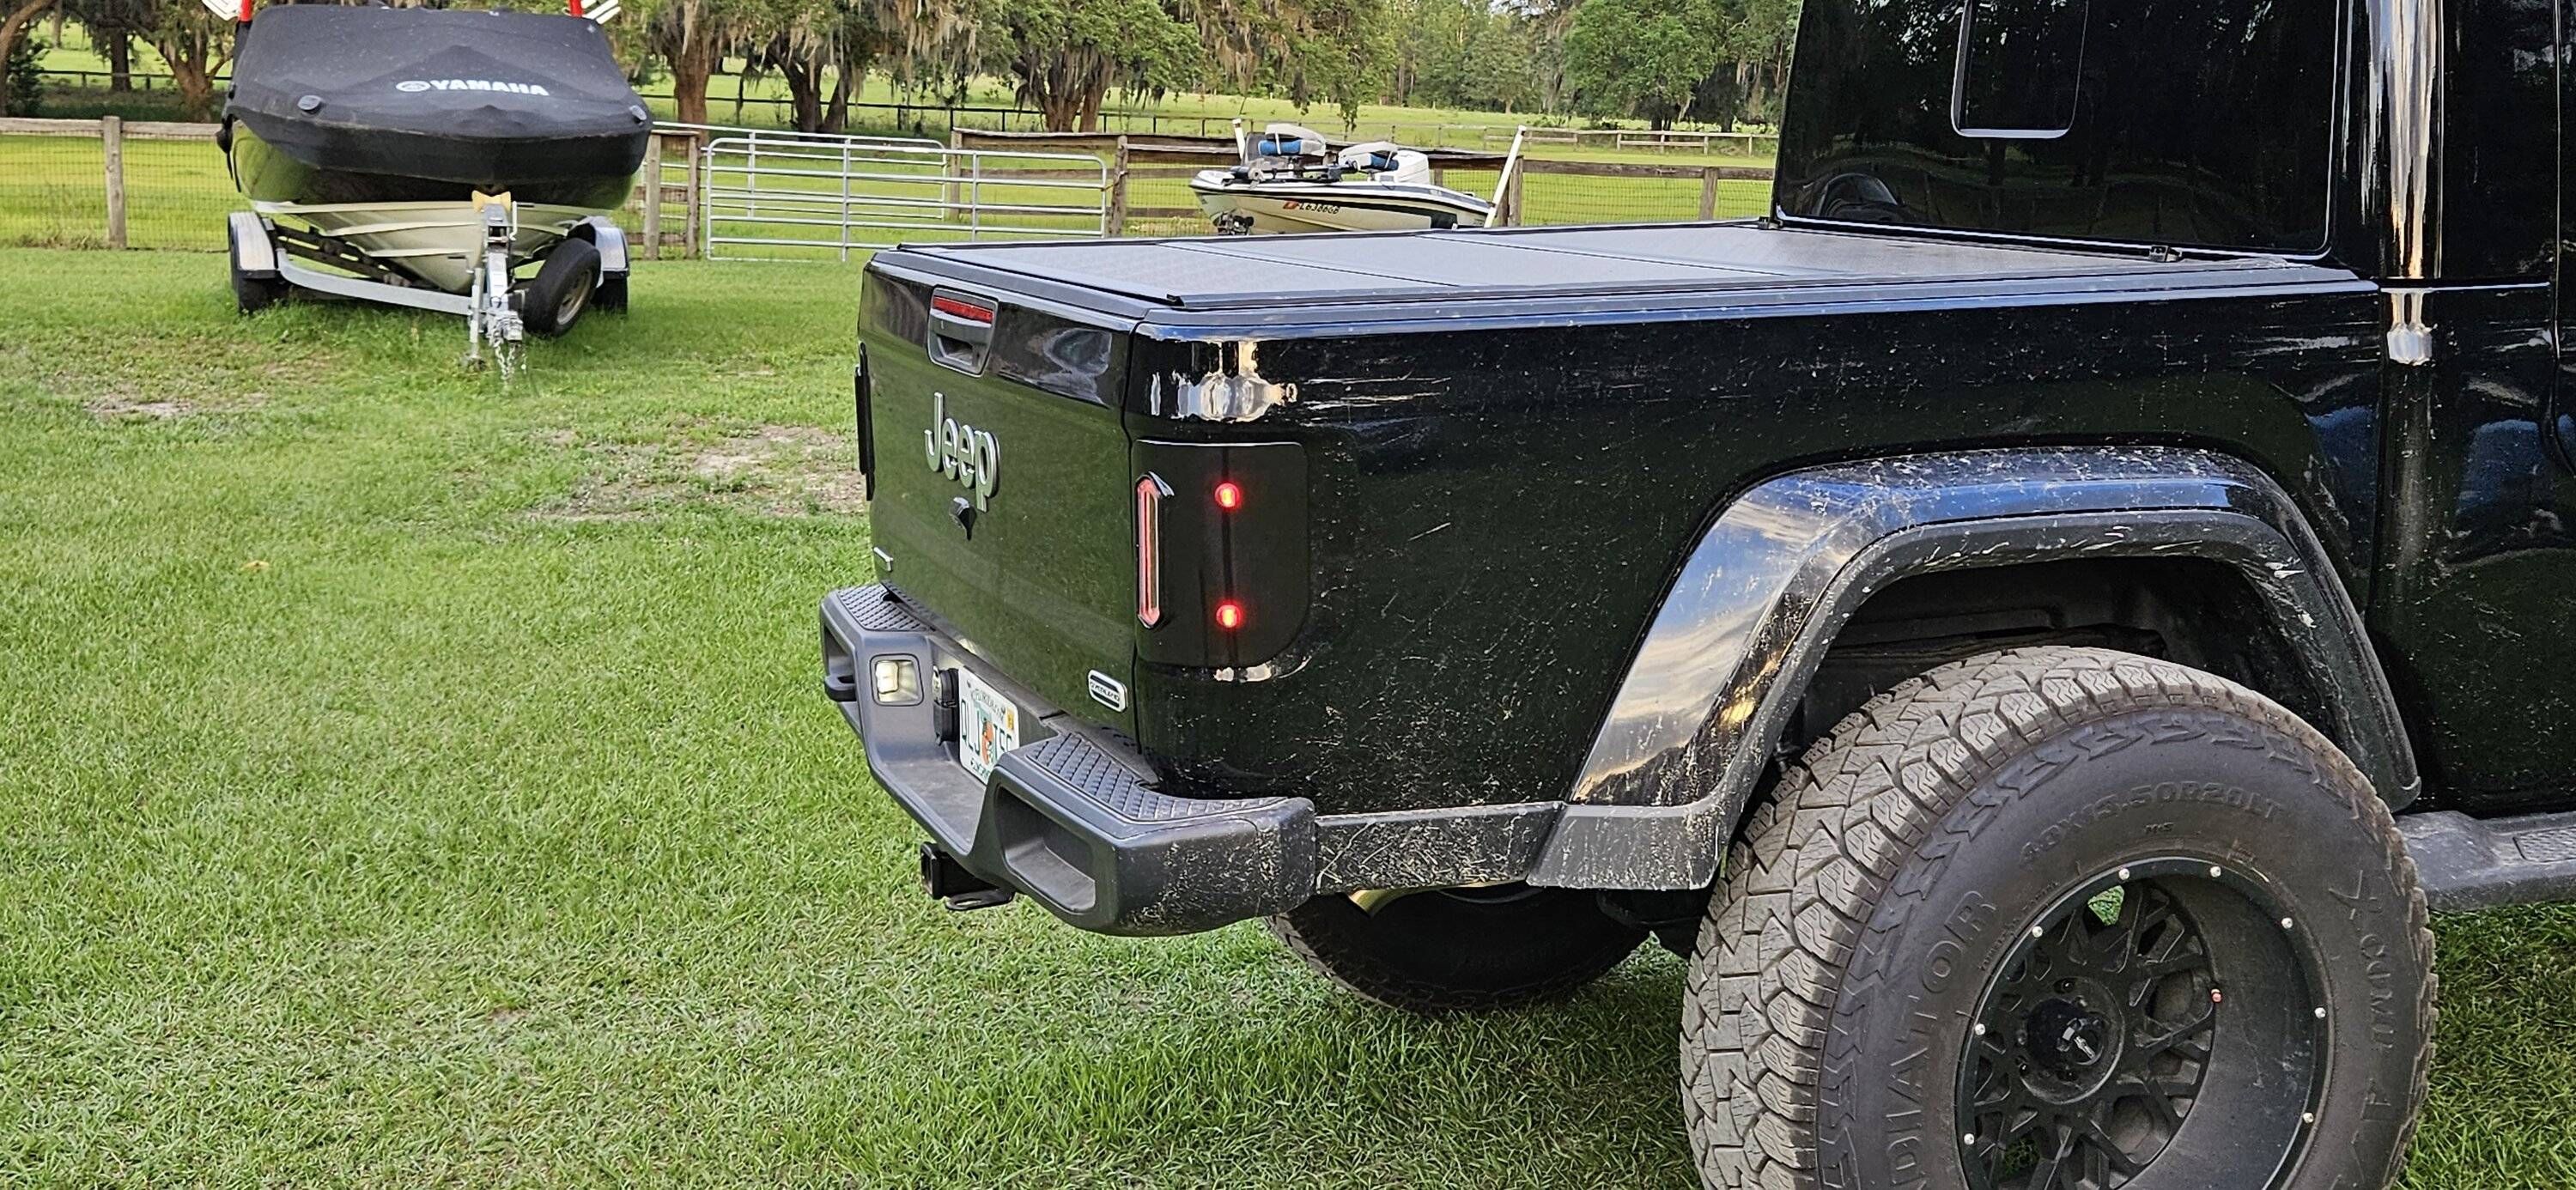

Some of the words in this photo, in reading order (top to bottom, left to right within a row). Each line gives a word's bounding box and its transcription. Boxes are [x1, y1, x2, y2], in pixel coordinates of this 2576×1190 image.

[430, 80, 550, 96] YAMAHA
[924, 392, 1000, 513] Jeep
[1886, 890, 1997, 1190] DIATOR
